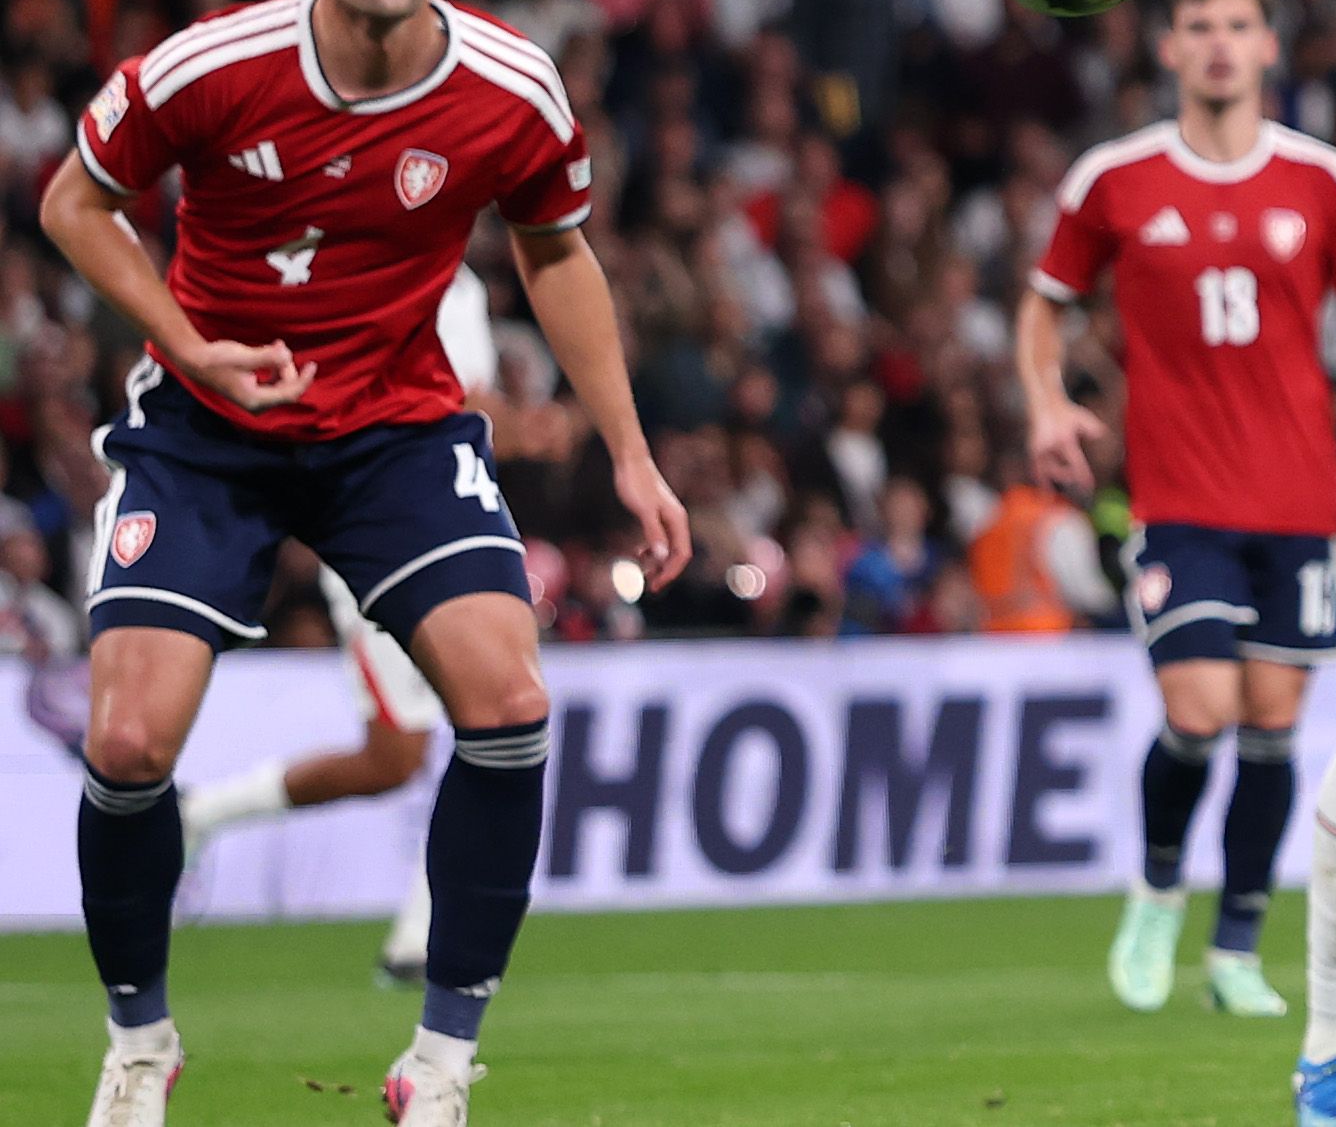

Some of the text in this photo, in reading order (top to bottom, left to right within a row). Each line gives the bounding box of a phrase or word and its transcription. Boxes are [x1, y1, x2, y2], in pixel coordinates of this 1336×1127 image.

[266, 224, 325, 286] 4
[452, 443, 500, 513] 4
[545, 692, 1112, 880] HOME
